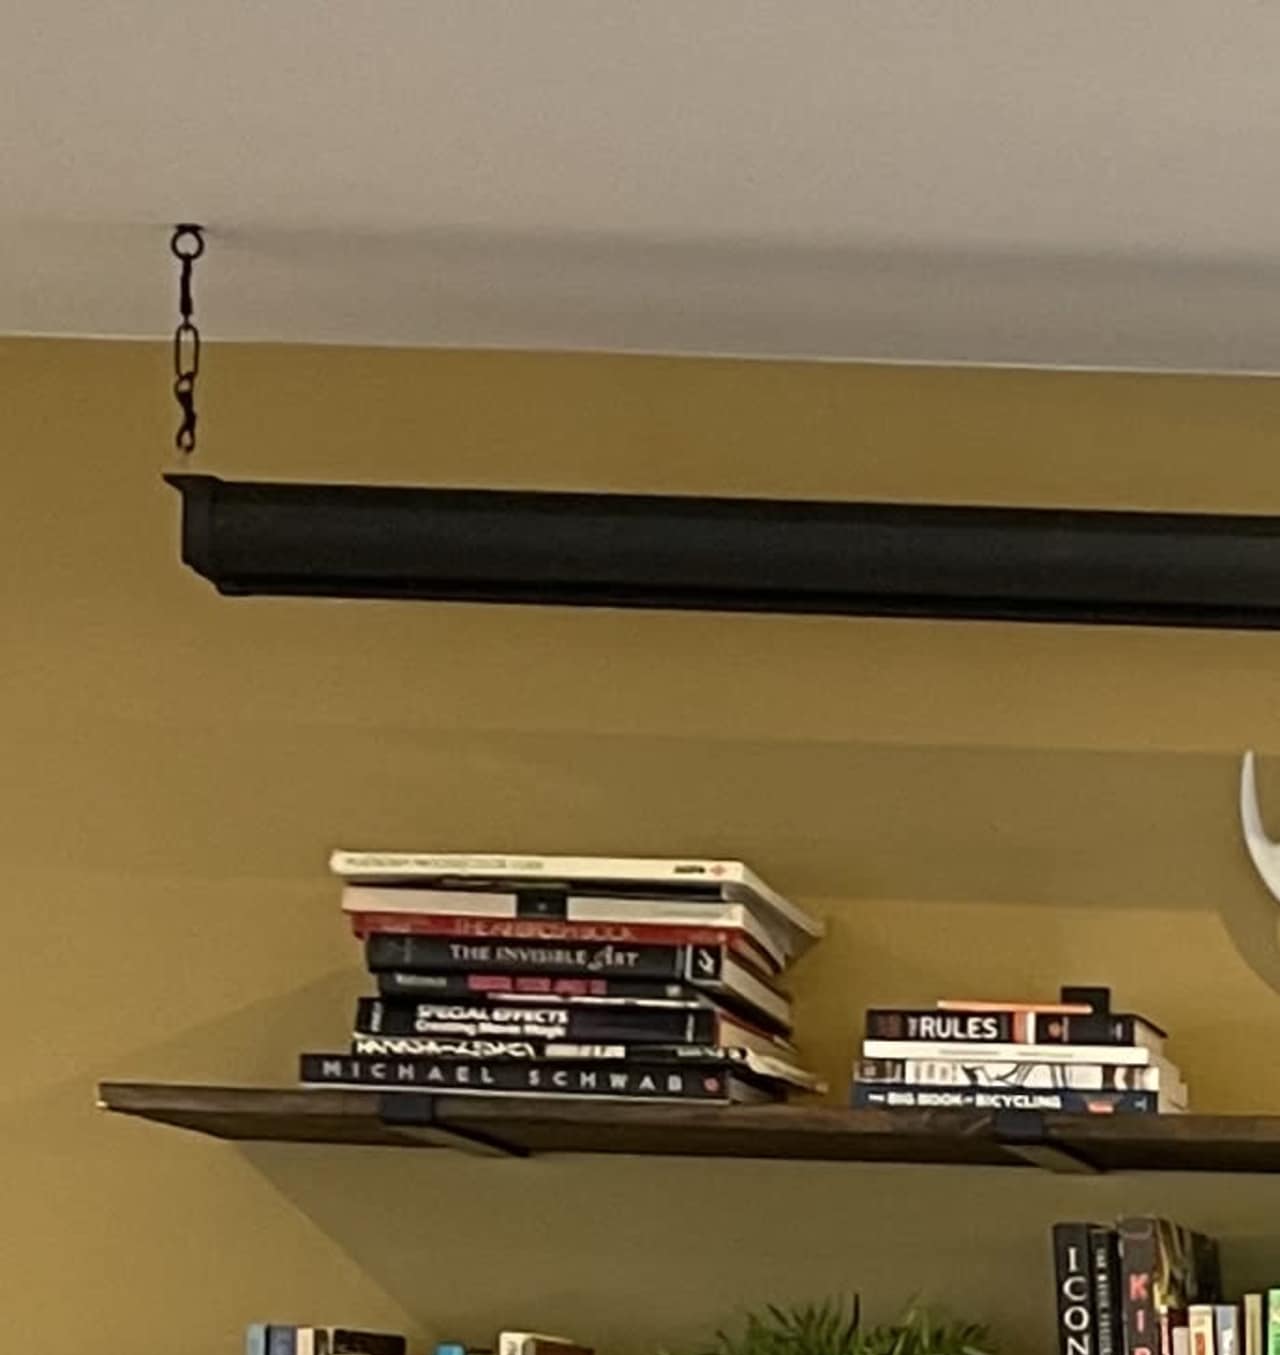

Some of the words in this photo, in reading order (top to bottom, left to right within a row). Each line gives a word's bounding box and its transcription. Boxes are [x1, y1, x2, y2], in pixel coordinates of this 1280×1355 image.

[450, 944, 490, 962] THE
[496, 946, 586, 966] INVISIBLE
[417, 1005, 489, 1022] SPECIAL
[492, 1008, 568, 1025] EFFECTS
[919, 1016, 1000, 1039] RULES
[322, 1059, 495, 1085] MICHAEL
[528, 1067, 683, 1092] SCHWAB
[975, 1094, 1063, 1109] BICYCLING
